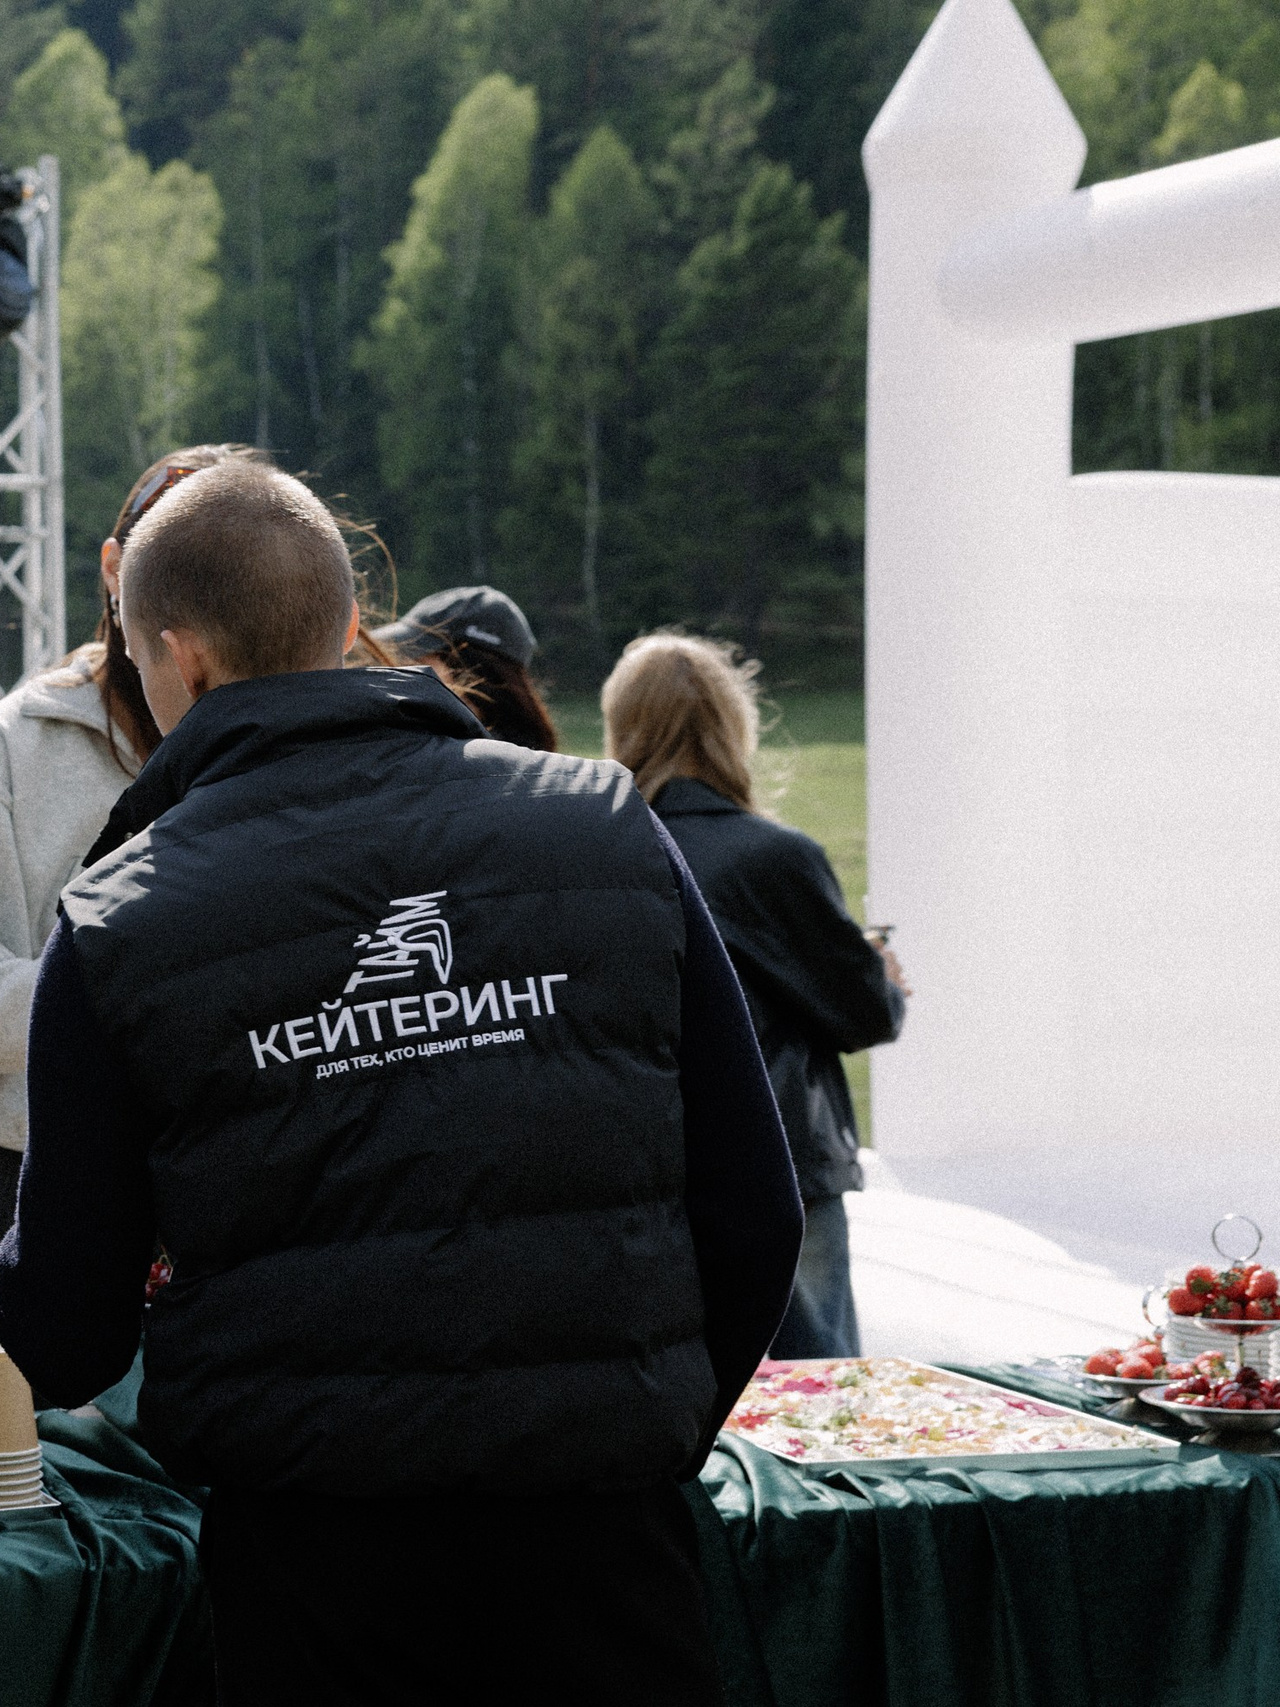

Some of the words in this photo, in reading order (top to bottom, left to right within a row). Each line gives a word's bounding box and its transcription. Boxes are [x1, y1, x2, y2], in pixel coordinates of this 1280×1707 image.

[247, 973, 569, 1070] КЕЙТЕРИНГ
[315, 1059, 350, 1080] ДЛЯ
[349, 1052, 384, 1068] ТЕХ,
[384, 1046, 416, 1063] КТО
[418, 1036, 469, 1058] ЦЕНИТ
[471, 1028, 526, 1048] ВРЕМЯ
